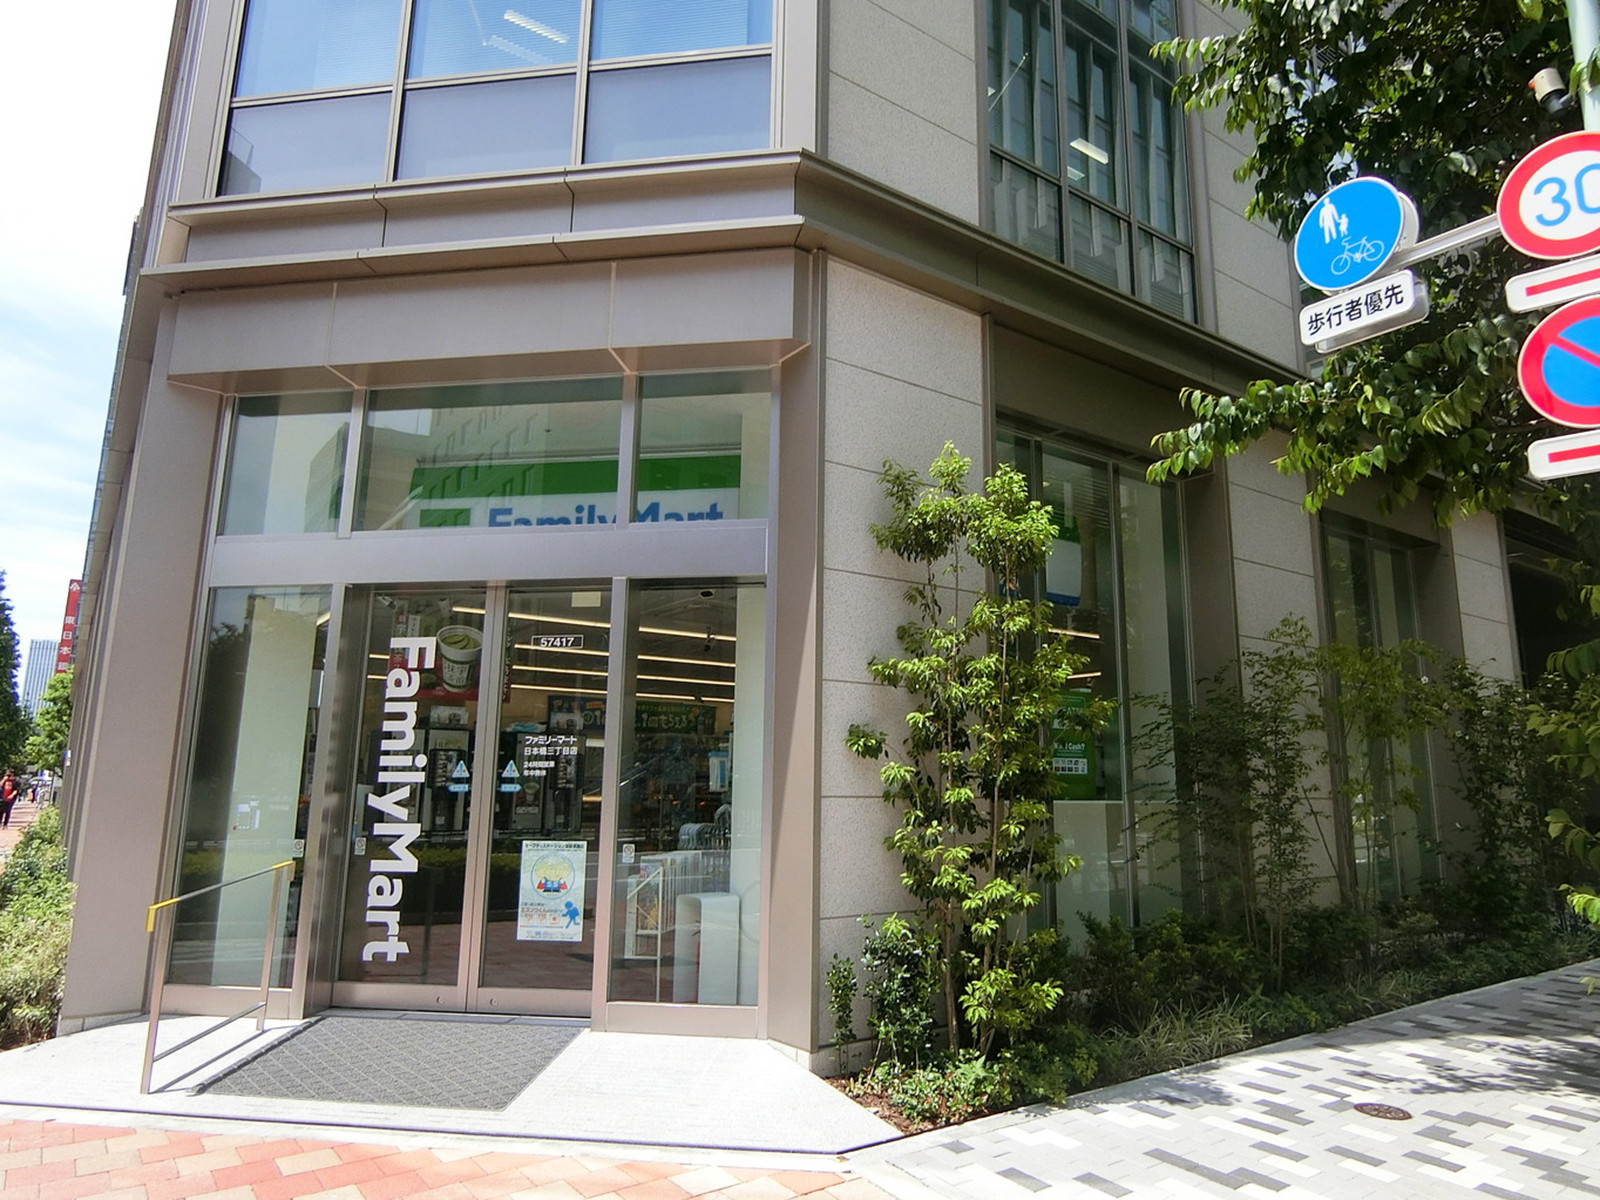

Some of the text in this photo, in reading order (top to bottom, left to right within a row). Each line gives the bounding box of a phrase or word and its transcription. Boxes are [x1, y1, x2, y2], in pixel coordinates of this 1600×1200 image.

[1533, 163, 1600, 227] 30
[1307, 283, 1404, 336] 歩行者優先
[540, 637, 575, 648] 57417
[524, 735, 578, 745] ファミリーマート
[524, 746, 578, 756] 日本橋三丁目店
[362, 636, 437, 962] FamilyMart
